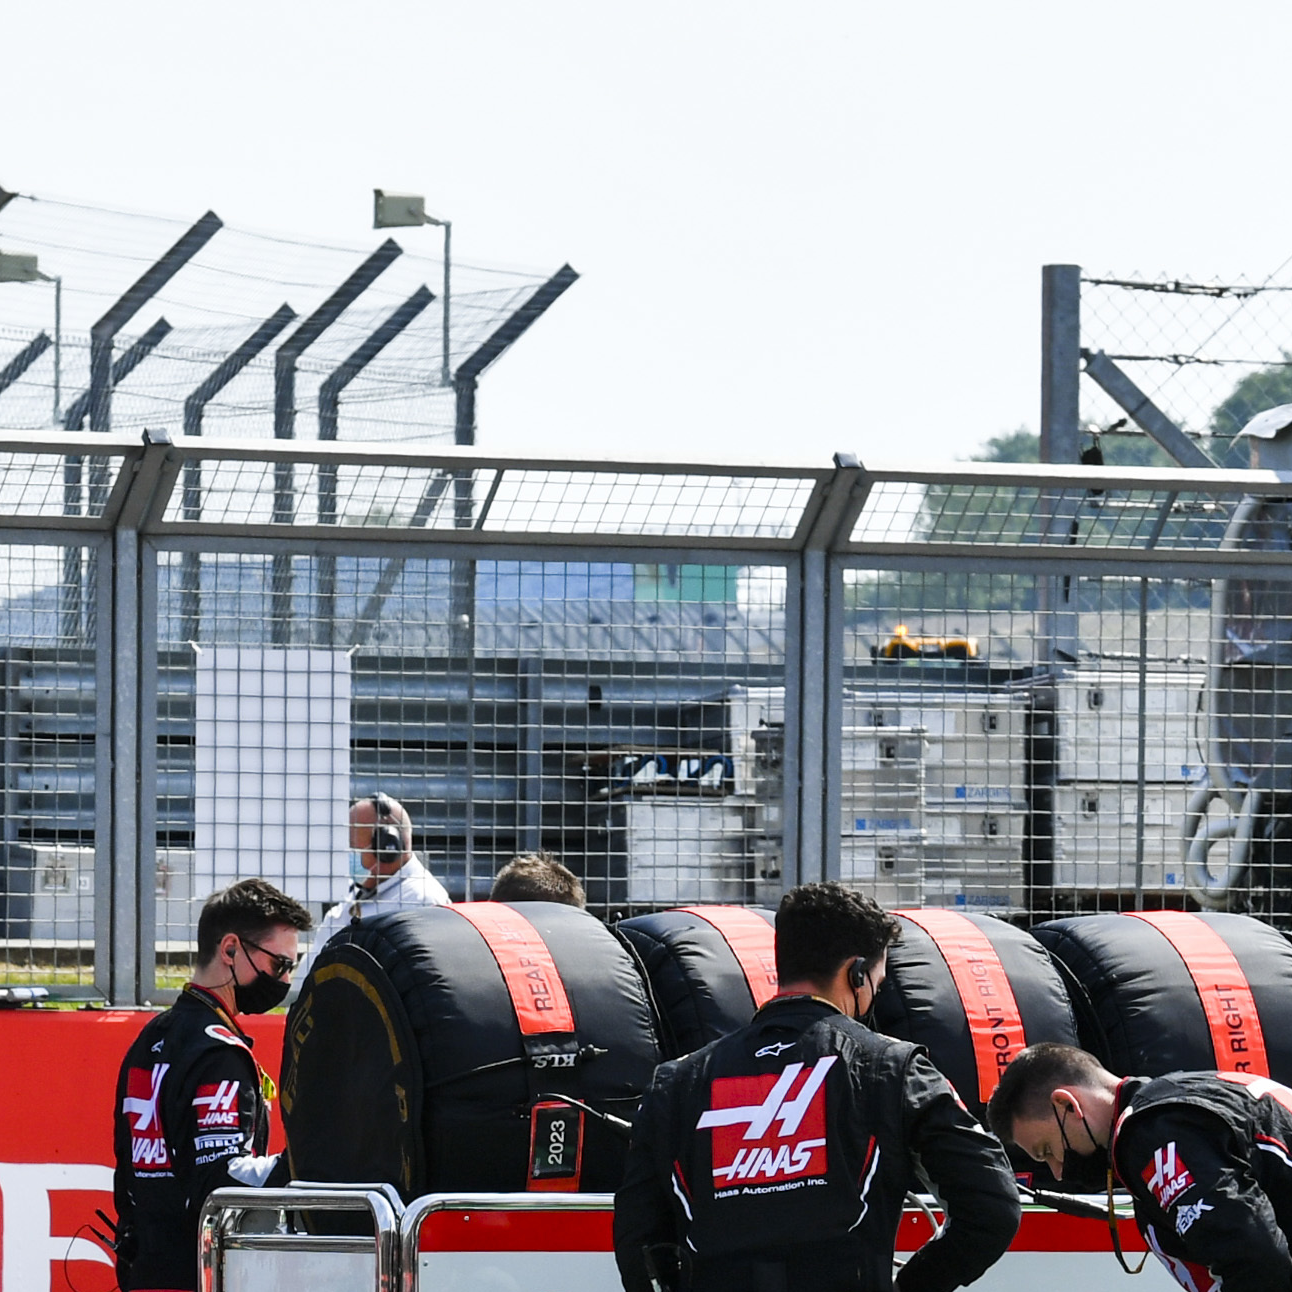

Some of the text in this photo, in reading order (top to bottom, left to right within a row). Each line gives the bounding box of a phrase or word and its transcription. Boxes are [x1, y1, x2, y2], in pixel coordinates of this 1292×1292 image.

[1214, 983, 1249, 1053] RIGHT
[197, 1111, 239, 1125] HAAS
[547, 1119, 566, 1165] 2023
[712, 1138, 827, 1181] HAAS
[714, 1178, 828, 1200] Haas Automation Inc.
